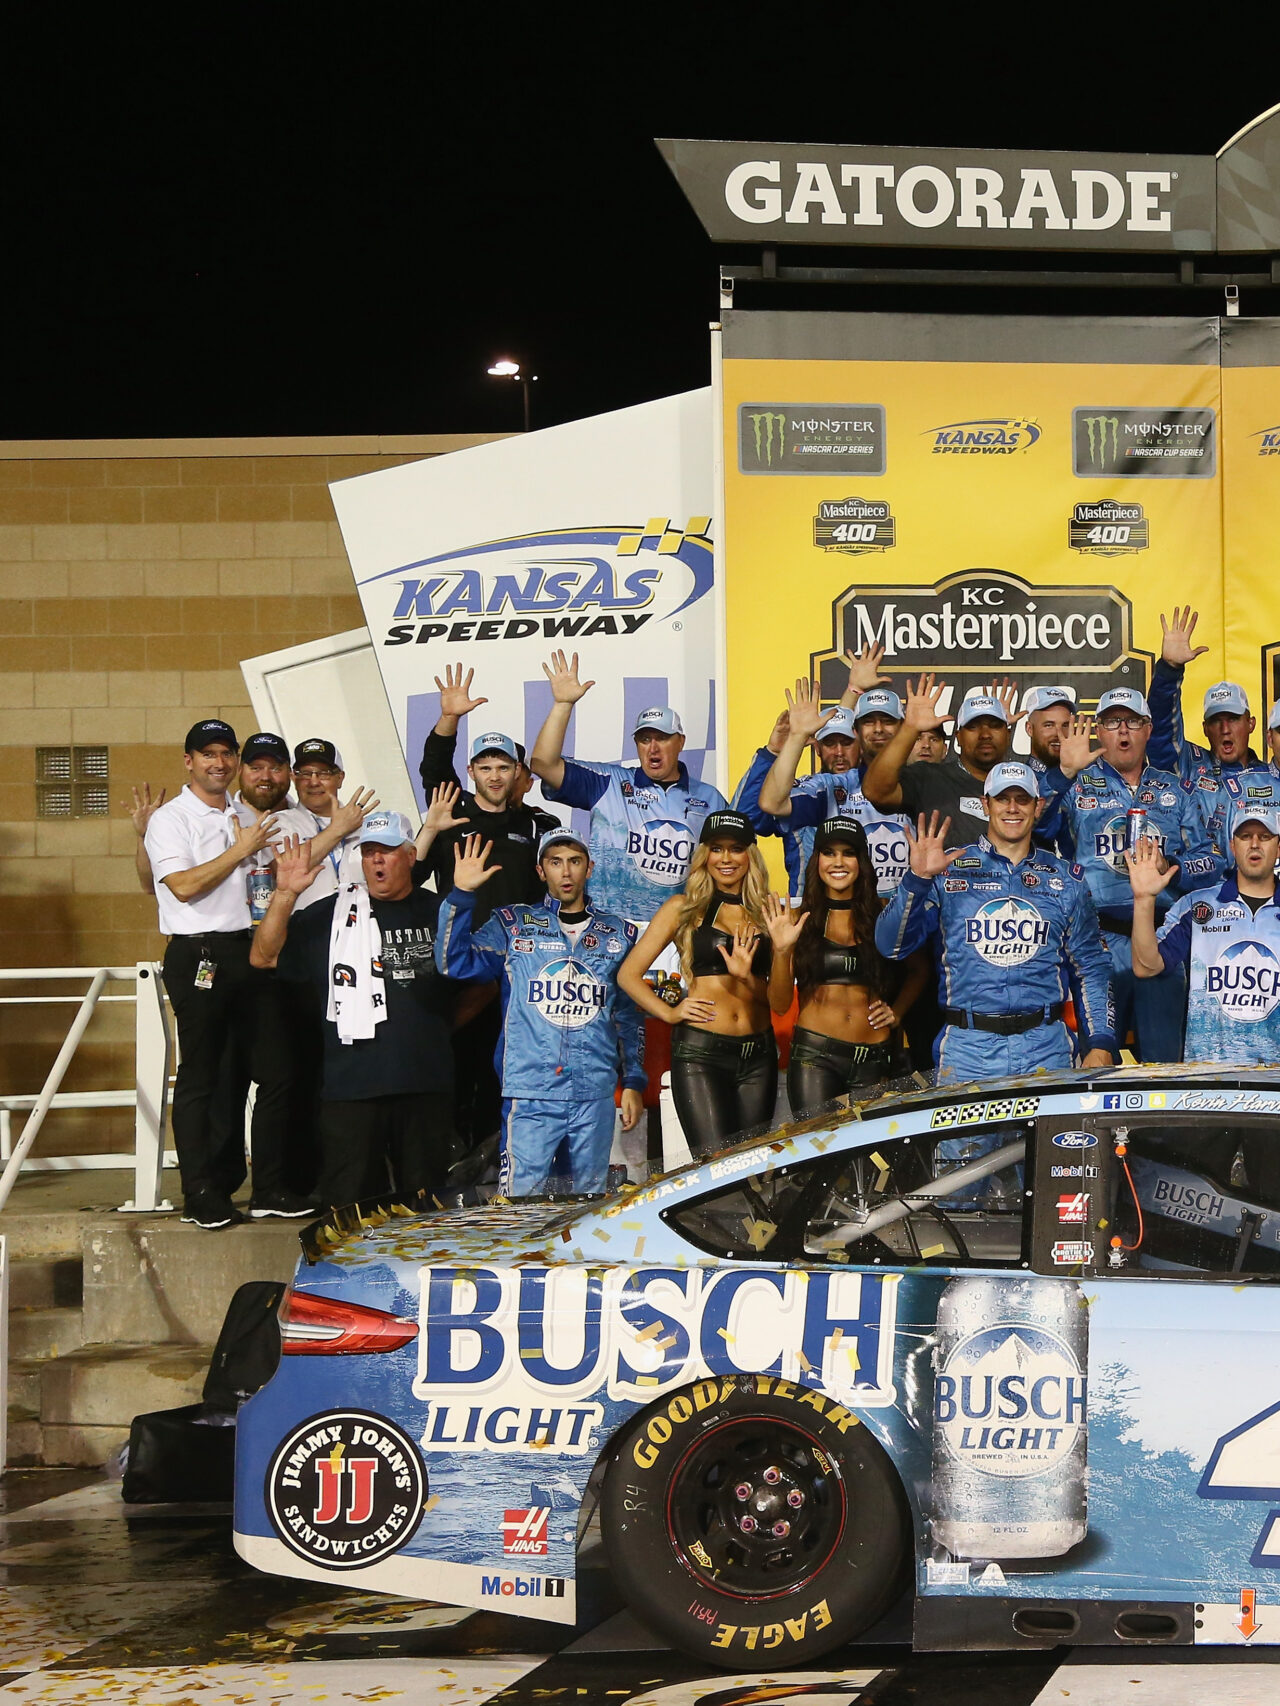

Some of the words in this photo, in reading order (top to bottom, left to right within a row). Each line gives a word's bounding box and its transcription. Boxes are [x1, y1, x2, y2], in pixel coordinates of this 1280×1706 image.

[725, 161, 1171, 231] GATORADE
[935, 429, 1019, 445] KANSAS
[802, 445, 832, 454] NASCAR
[833, 445, 848, 453] CUP
[849, 446, 874, 454] SERIES
[1134, 448, 1163, 457] NASCAR
[1164, 448, 1178, 456] CUP
[1179, 449, 1204, 457] SERIES
[824, 504, 885, 519] Masterpiece
[1078, 507, 1138, 522] Masterpiece
[832, 524, 877, 542] 400
[1086, 526, 1131, 544] 400
[391, 557, 663, 620] KANSAS
[961, 587, 1005, 606] KC
[384, 613, 654, 646] SPEEDWAY
[853, 601, 1111, 660] Masterpiece
[1001, 768, 1026, 777] BUSCH
[366, 818, 389, 829] BUSCH
[640, 856, 690, 874] LIGHT
[1185, 857, 1216, 875] BUSCH
[1217, 908, 1245, 918] BUSCH
[965, 919, 1050, 945] BUSCH
[983, 944, 1034, 955] LIGHT
[528, 979, 607, 1008] BUSCH
[1222, 993, 1269, 1008] LIGHT
[545, 1004, 593, 1015] LIGHT
[1061, 1133, 1088, 1146] Ford
[1154, 1179, 1225, 1217] BUSCH
[1166, 1206, 1205, 1224] LIGHT
[422, 1267, 892, 1397] BUSCH
[936, 1375, 1087, 1423] BUSCH
[432, 1406, 597, 1446] LIGHT
[633, 1375, 860, 1468] GOODYEAR
[959, 1427, 1063, 1450] LIGHT
[282, 1425, 343, 1489] JIMMY
[284, 1503, 409, 1556] SANDWICHES
[503, 1540, 548, 1553] HAAS
[482, 1576, 541, 1597] Mobil
[545, 1578, 565, 1597] 1
[711, 1599, 833, 1649] EAGLE
